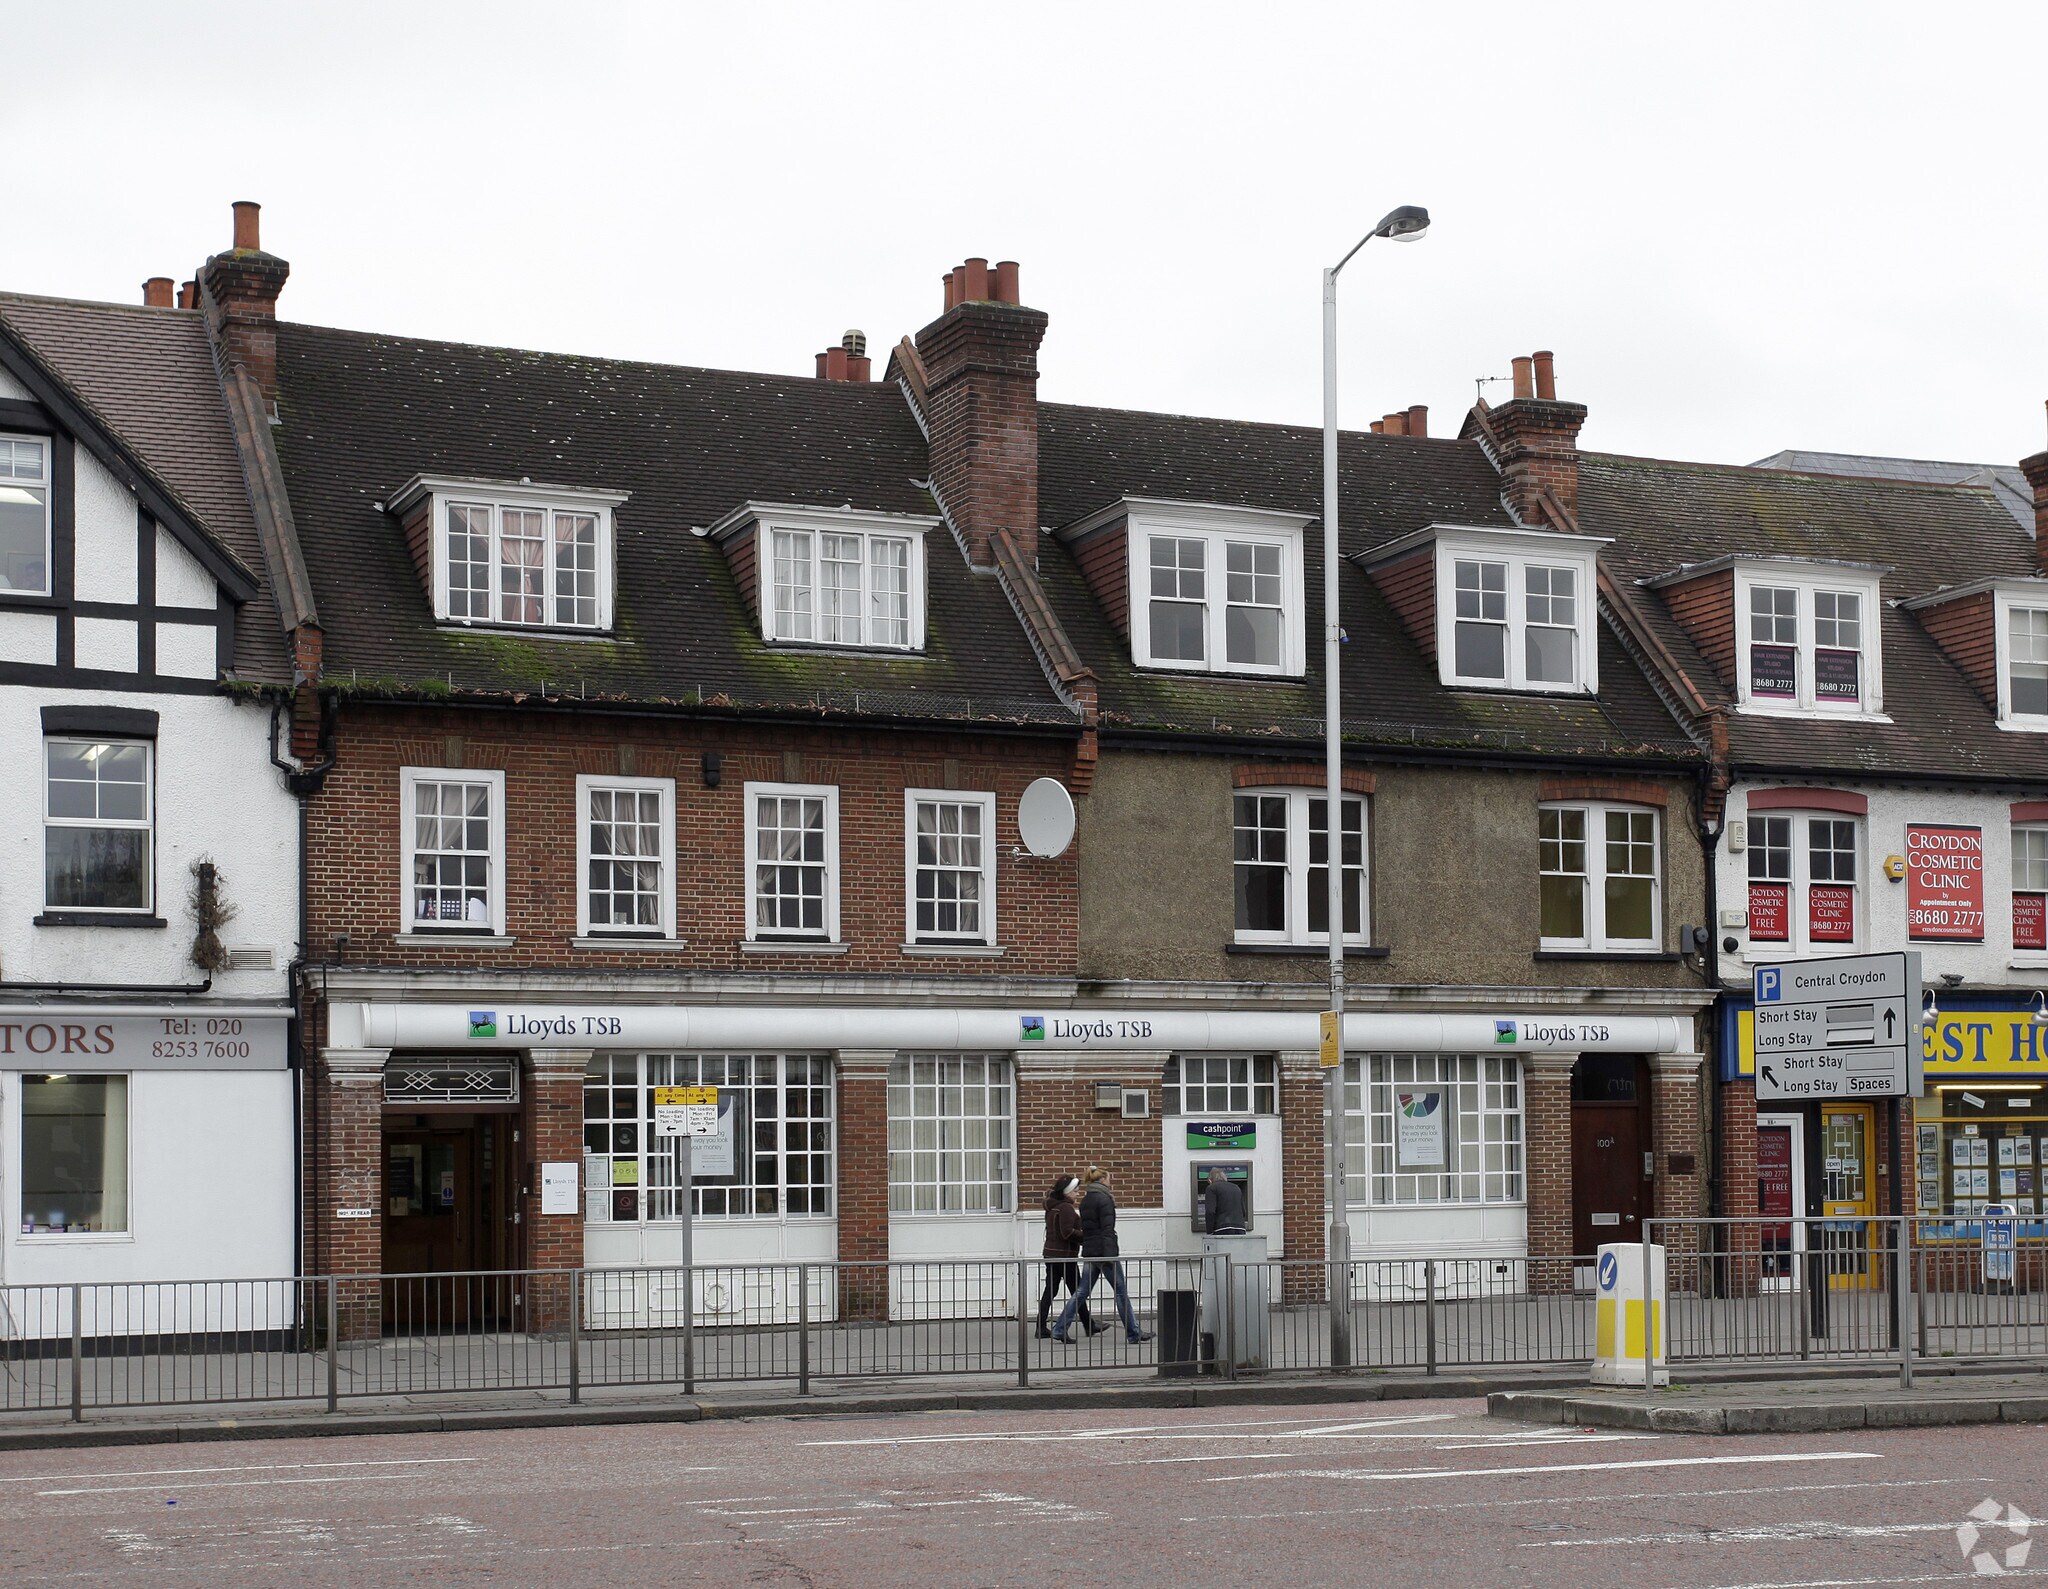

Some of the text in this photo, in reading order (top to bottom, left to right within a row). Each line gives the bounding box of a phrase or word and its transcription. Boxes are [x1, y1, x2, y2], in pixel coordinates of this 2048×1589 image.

[1757, 678, 1774, 687] 8680
[1776, 679, 1793, 688] 2777
[1820, 682, 1838, 692] 8680
[1840, 683, 1856, 693] 2777
[1908, 832, 1981, 850] CROYDON
[1908, 852, 1982, 870] COSMETIC
[1920, 871, 1971, 889] CLINIC
[1811, 890, 1849, 899] CROYDON
[1811, 899, 1848, 908] COSMETIC
[1920, 899, 1957, 907] Appointment
[1752, 907, 1778, 916] CLINIC
[1817, 908, 1843, 917] CLINIC
[1915, 910, 1949, 925] 8680
[1953, 911, 1983, 926] 2777
[1756, 918, 1775, 928] FREE
[1813, 921, 1832, 930] 8680
[1834, 922, 1850, 931] 2777
[2013, 916, 2036, 925] CLINIC
[2016, 926, 2034, 937] FREE
[1762, 970, 1886, 998] P Central Croydon
[1759, 1009, 1817, 1023] Short Stay
[160, 1018, 242, 1035] Tel: 020
[507, 1014, 622, 1040] Lloyds TSB
[1053, 1019, 1153, 1043] Lloyds TSB
[0, 1023, 115, 1054] TORS
[1523, 1023, 1610, 1046] Lloyds TSB
[1759, 1032, 1812, 1046] Long Stay
[2009, 1023, 2048, 1061] H
[152, 1041, 250, 1058] 8253 7600
[1784, 1055, 1843, 1069] Short Stay
[1784, 1078, 1891, 1093] Long Stay Spaces
[1203, 1124, 1241, 1134] cashpoint
[1774, 1170, 1788, 1178] 2777
[1772, 1183, 1788, 1191] FREE
